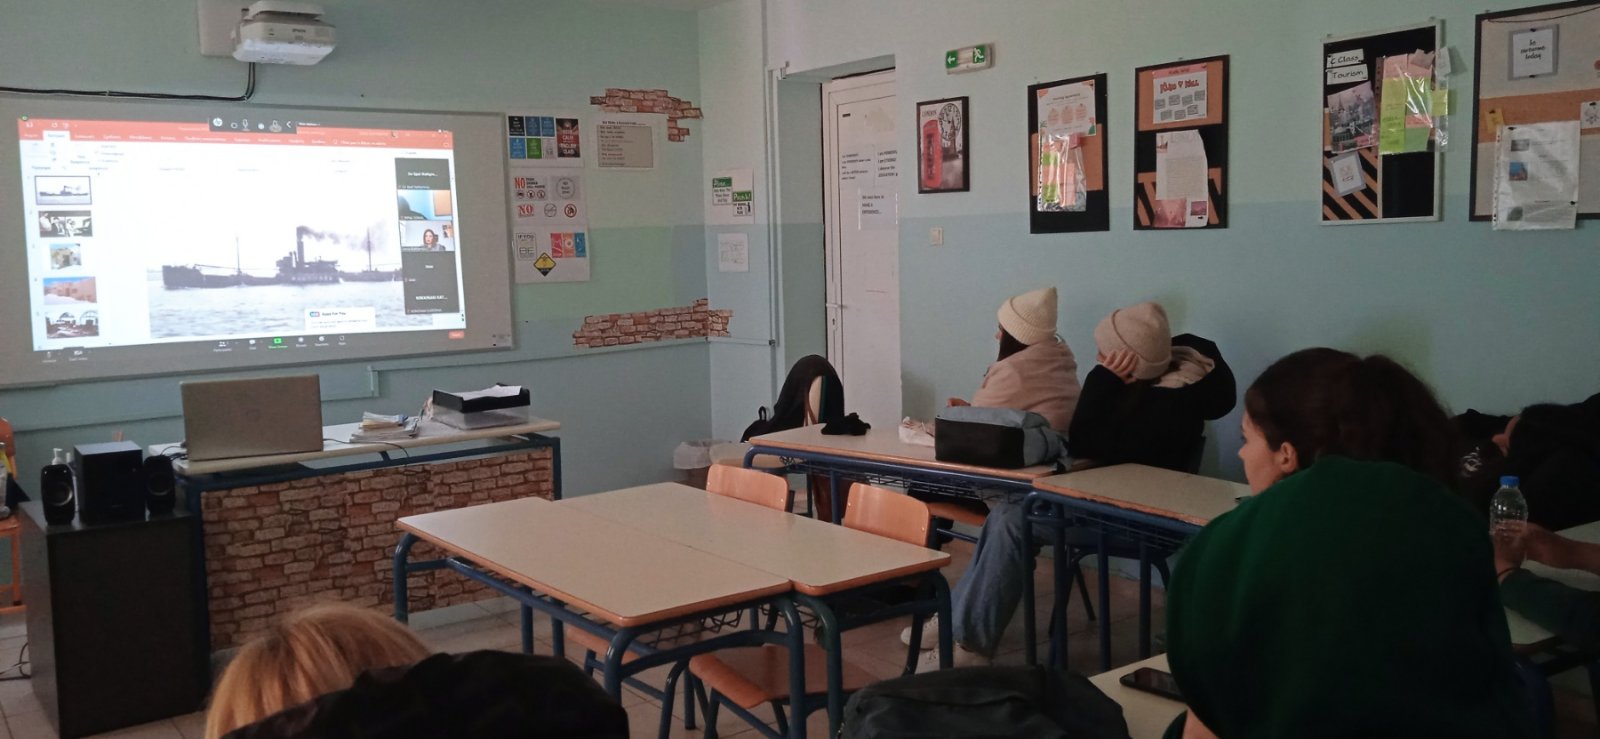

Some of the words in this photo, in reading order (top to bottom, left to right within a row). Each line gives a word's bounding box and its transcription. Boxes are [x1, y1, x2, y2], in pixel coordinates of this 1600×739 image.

[1337, 55, 1359, 63] Class
[1332, 70, 1364, 79] Tourism
[514, 177, 526, 189] NO
[517, 204, 534, 215] NO
